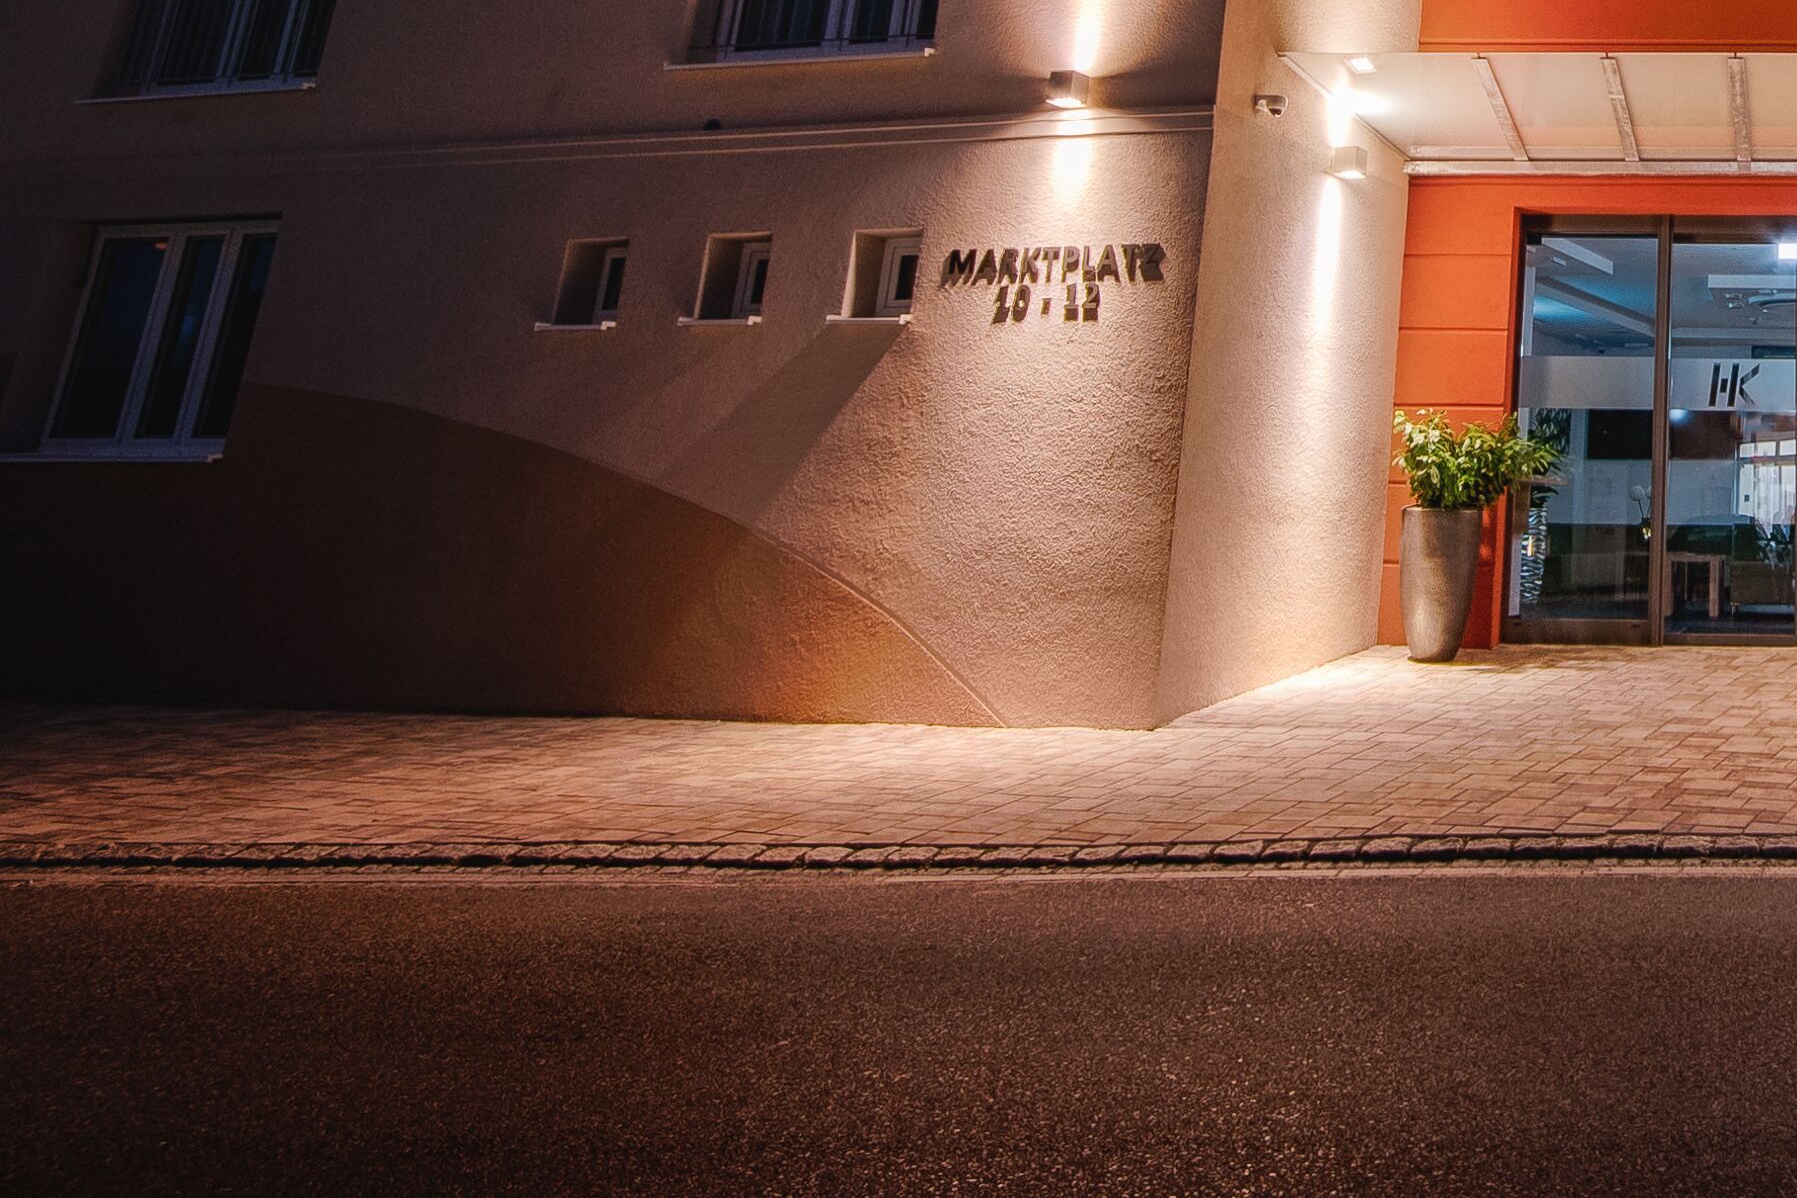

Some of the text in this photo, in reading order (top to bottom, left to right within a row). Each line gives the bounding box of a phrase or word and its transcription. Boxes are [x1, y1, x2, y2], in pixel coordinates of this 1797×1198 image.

[942, 243, 1166, 285] MARKTPLATZ
[993, 284, 1031, 321] 10
[1064, 283, 1100, 321] 12
[1708, 362, 1760, 407] HK
